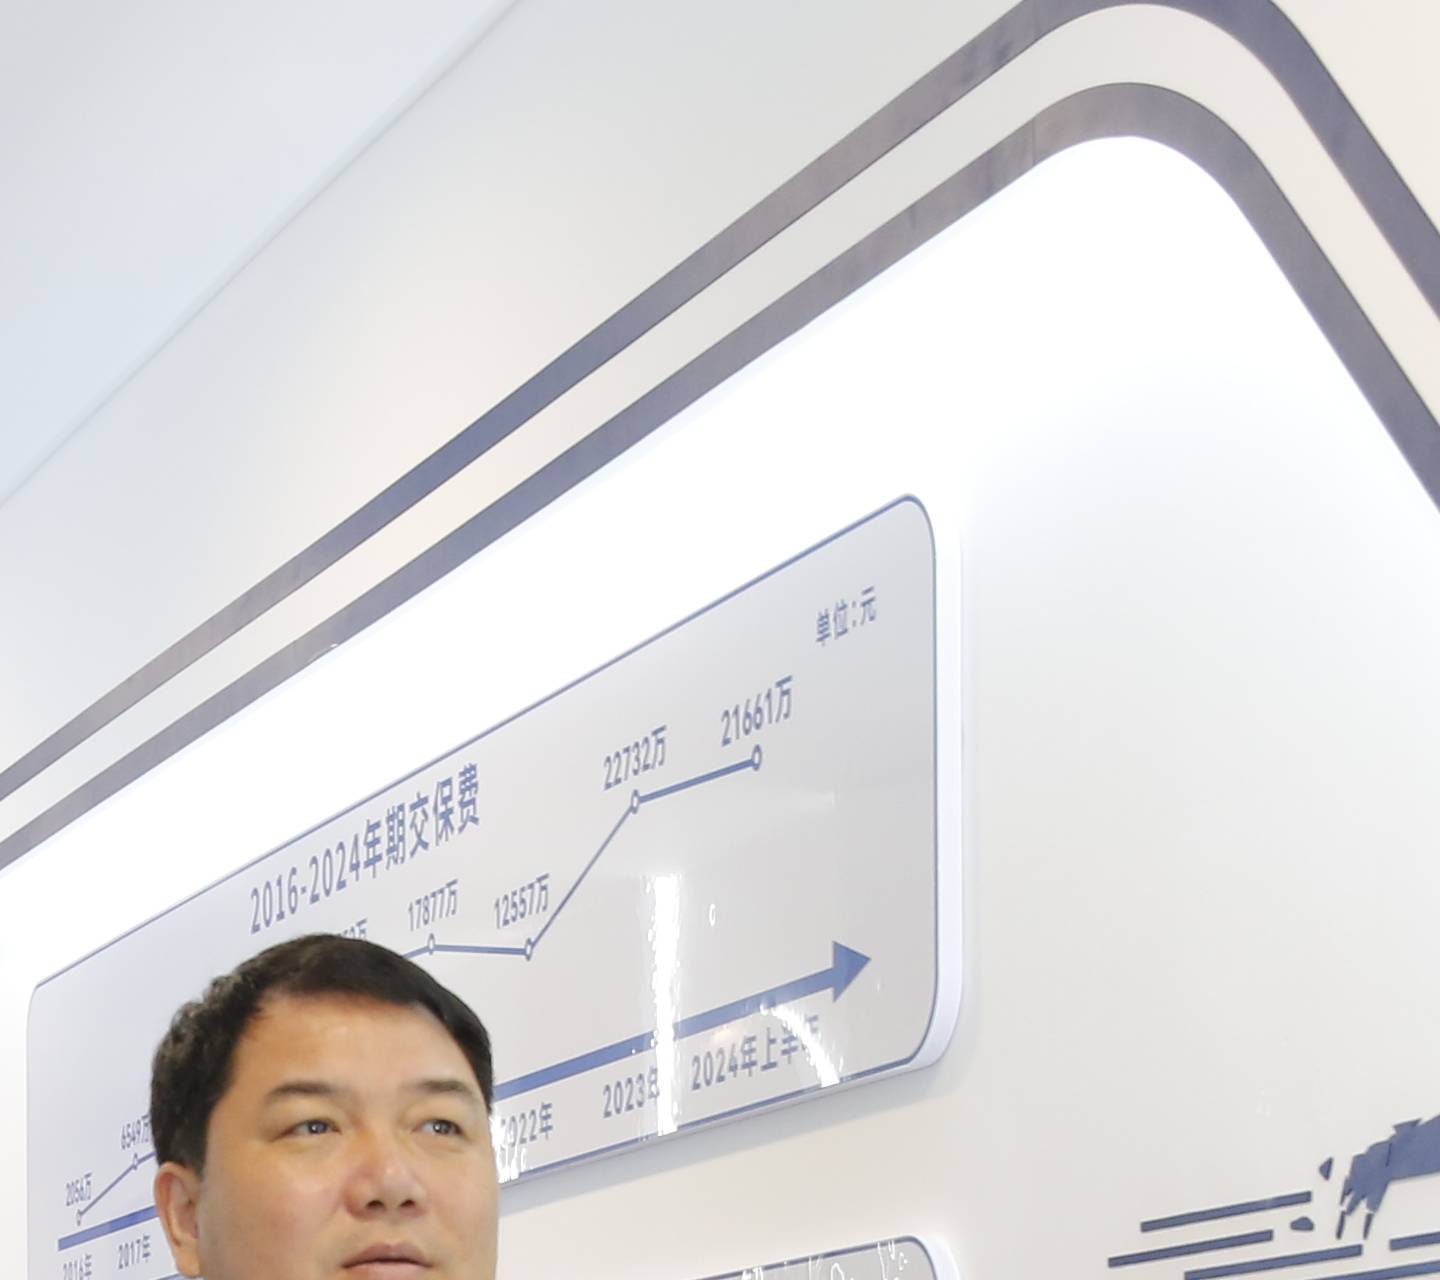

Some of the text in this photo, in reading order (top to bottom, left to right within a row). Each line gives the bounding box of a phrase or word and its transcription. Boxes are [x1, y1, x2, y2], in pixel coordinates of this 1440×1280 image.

[720, 675, 793, 747] 21661万
[603, 724, 668, 791] 22732万
[250, 762, 480, 936] 2016-2024年期交保费
[407, 878, 459, 932] 17877万
[493, 873, 550, 930] 12557万
[118, 1234, 151, 1271] 2017年
